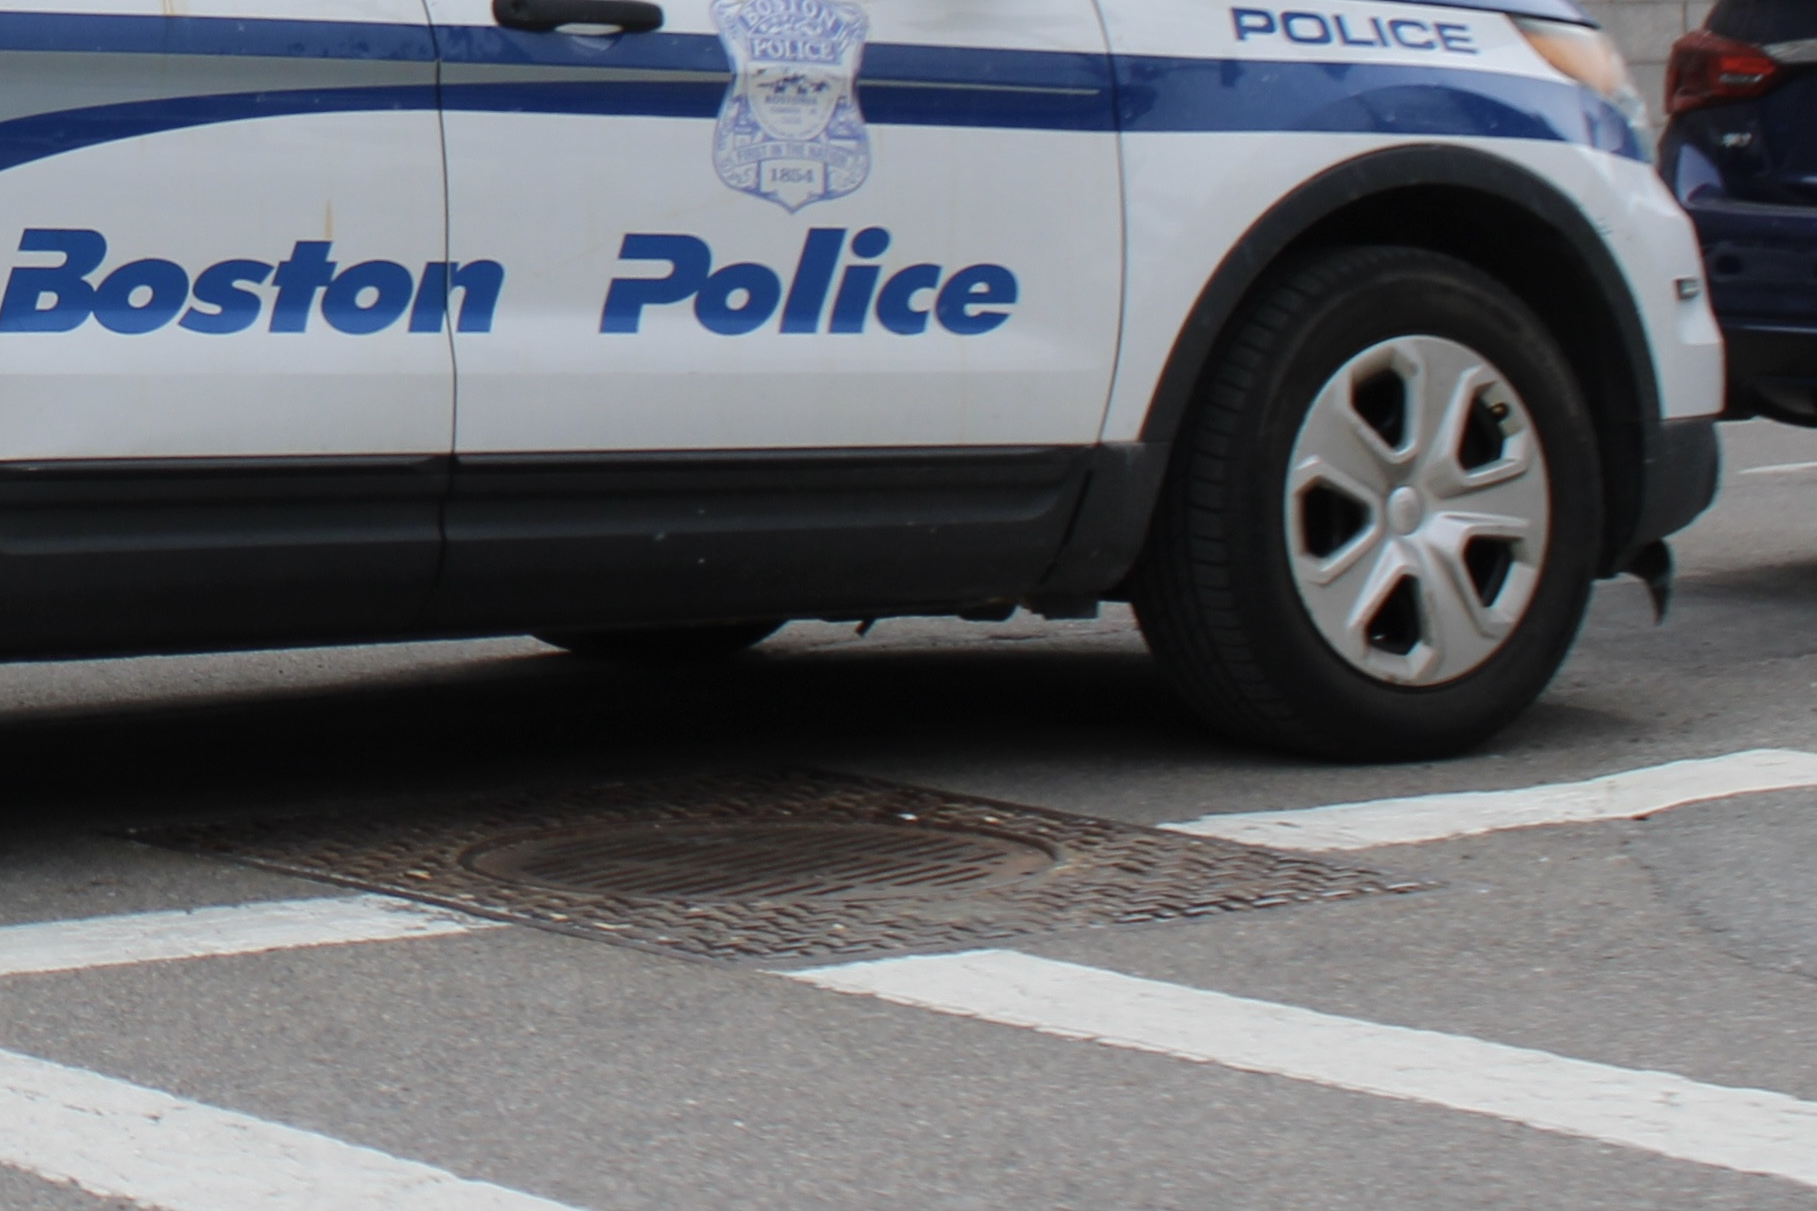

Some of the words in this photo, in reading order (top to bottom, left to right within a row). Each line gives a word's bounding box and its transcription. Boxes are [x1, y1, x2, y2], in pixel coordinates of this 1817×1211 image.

[752, 37, 836, 60] POLICE
[1230, 7, 1478, 54] POLICE
[597, 226, 1019, 337] Police
